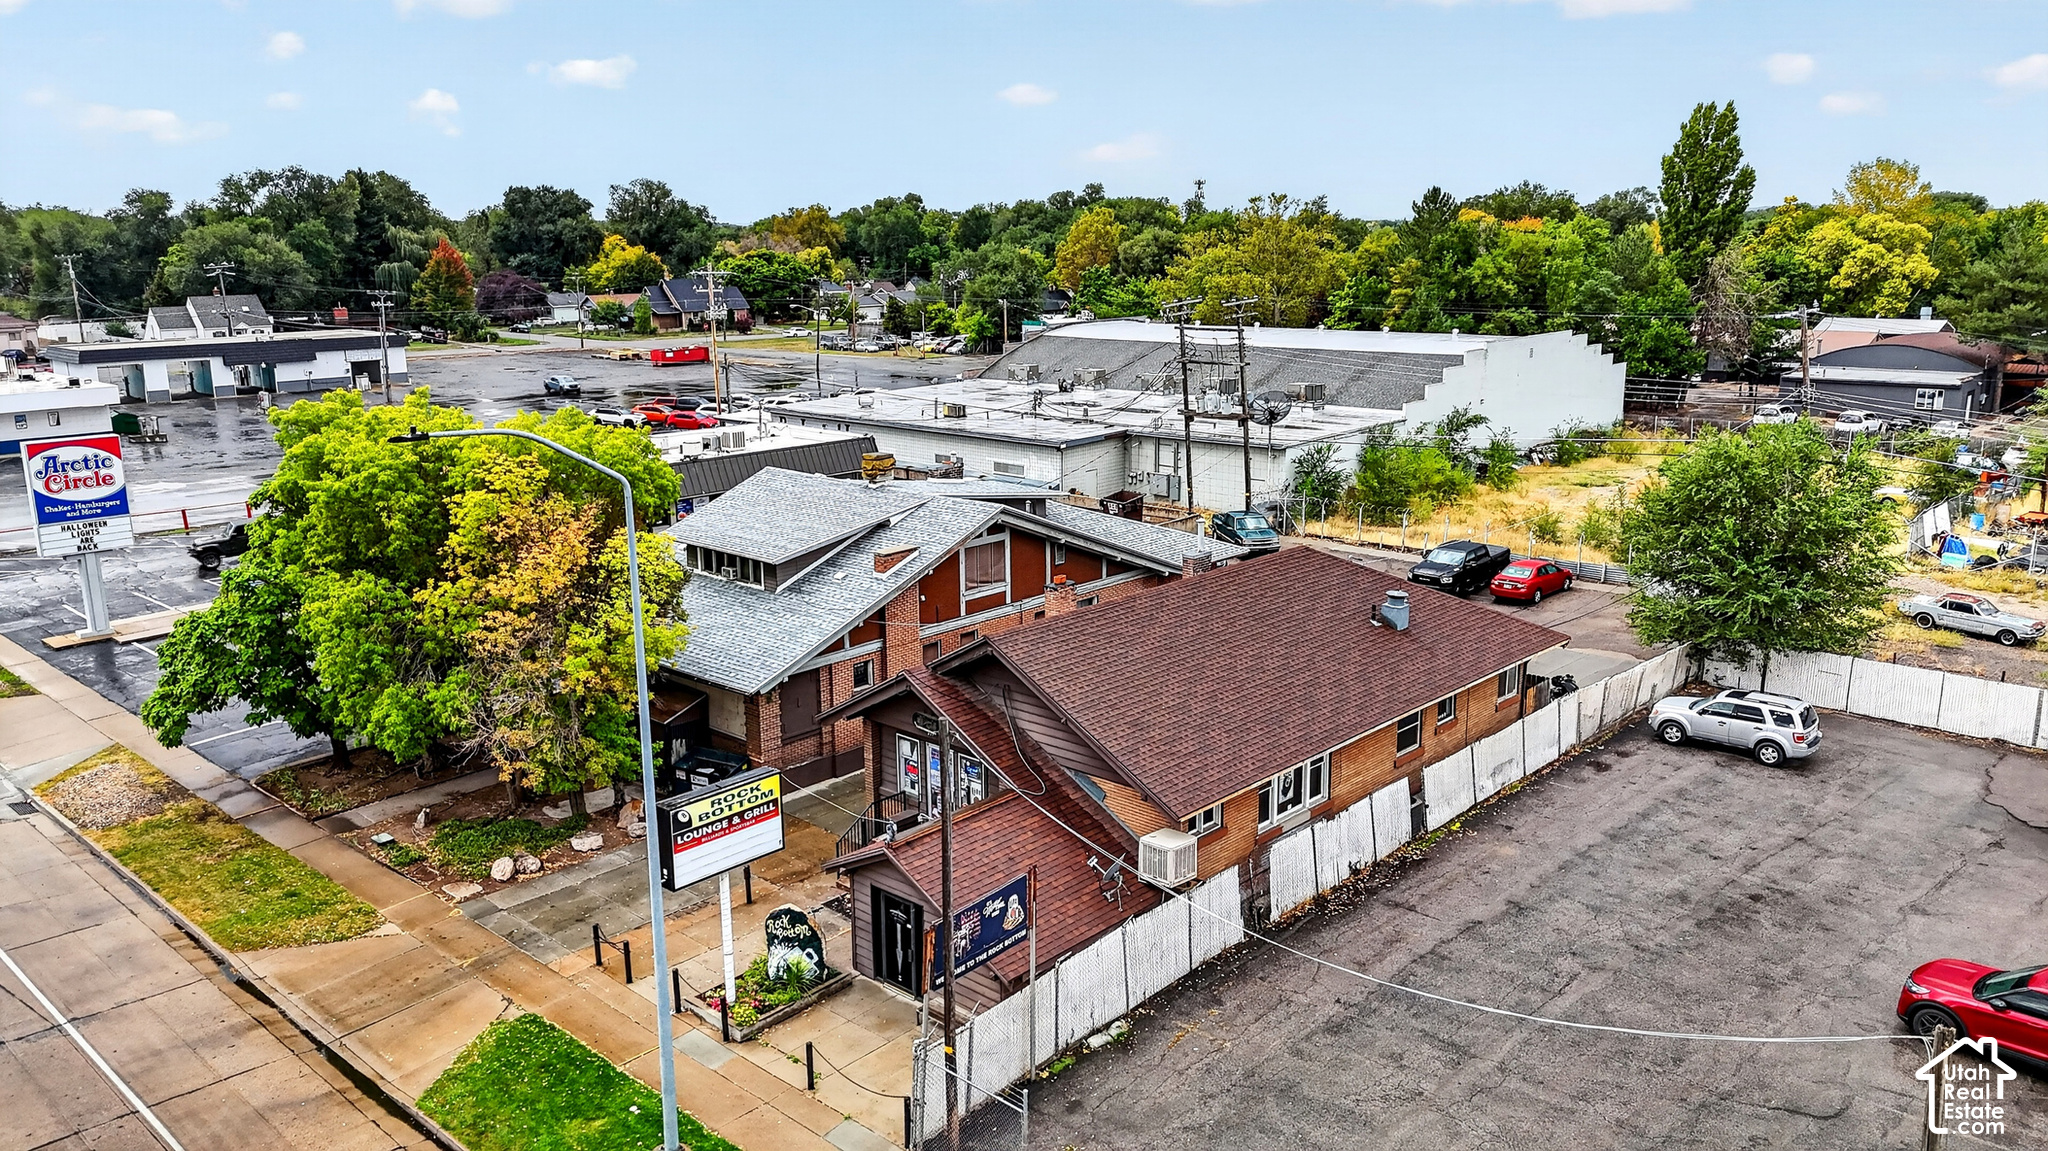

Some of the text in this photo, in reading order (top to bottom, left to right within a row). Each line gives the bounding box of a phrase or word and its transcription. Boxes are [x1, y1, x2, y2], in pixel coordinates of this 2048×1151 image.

[36, 454, 113, 479] Arctic
[44, 471, 115, 494] Circle
[75, 500, 121, 510] Hamburgers
[81, 508, 102, 516] More
[61, 520, 108, 533] HALLOWEEN
[71, 528, 100, 538] LIGHTS
[80, 536, 94, 545] ARE
[77, 543, 99, 552] BACK
[710, 783, 762, 809] ROCK
[698, 789, 774, 823] BOTTOM
[677, 802, 776, 845] LOUNGE & GRILL
[701, 831, 725, 843] BILLIARDS
[966, 959, 975, 969] TO
[976, 951, 987, 963] THE
[987, 942, 1004, 957] ROCK
[1004, 928, 1027, 947] BOTTOM
